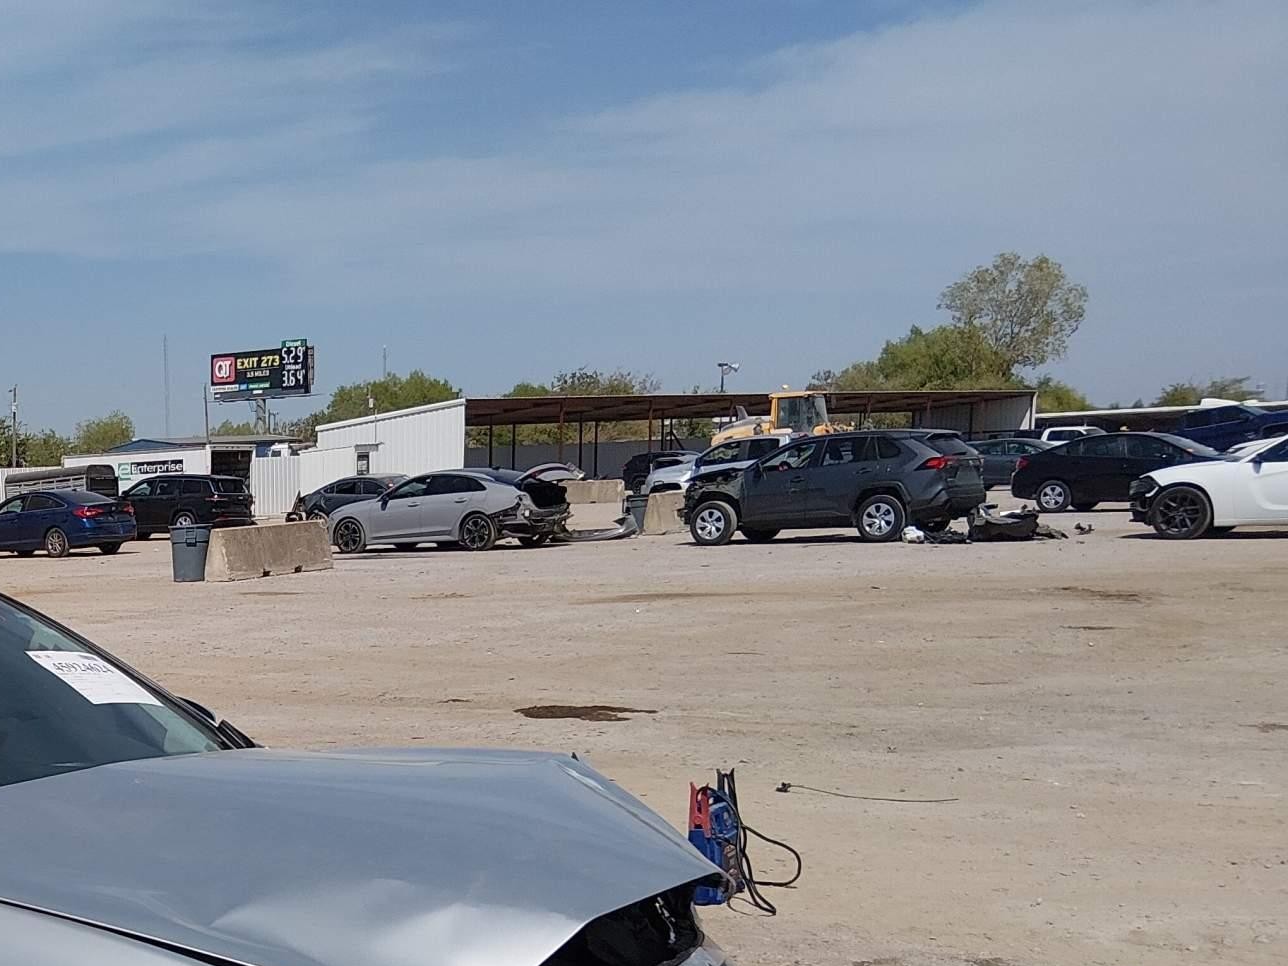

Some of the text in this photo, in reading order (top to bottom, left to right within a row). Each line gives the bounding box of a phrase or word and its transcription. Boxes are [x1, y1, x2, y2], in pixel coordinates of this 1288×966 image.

[236, 355, 280, 369] EXIT 273
[215, 361, 232, 379] QT
[131, 461, 183, 474] Enterprise
[52, 661, 114, 675] 45924624
